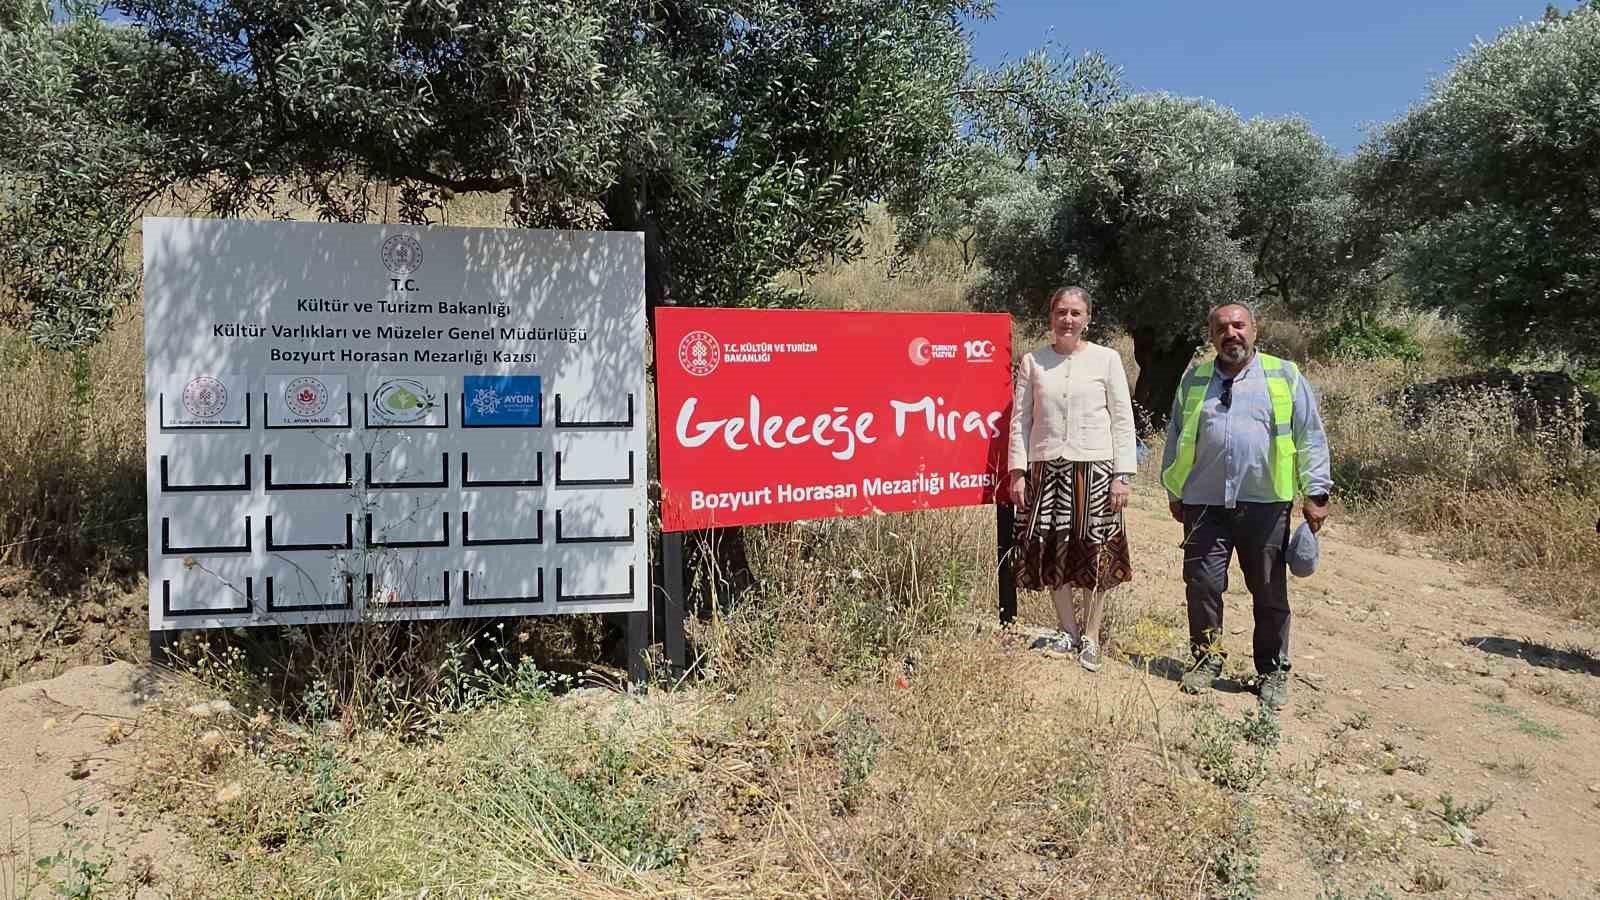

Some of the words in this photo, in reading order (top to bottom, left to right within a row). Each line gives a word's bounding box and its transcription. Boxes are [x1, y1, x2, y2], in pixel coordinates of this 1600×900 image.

[391, 279, 420, 292] T.C.
[297, 298, 349, 313] Kültür
[354, 303, 373, 314] ve
[377, 300, 433, 314] Turizm
[438, 301, 511, 318] Bakanlığı
[213, 323, 267, 338] Kültür
[271, 325, 347, 339] Varlıkları
[352, 329, 372, 340] ve
[377, 326, 443, 341] Müzeler
[448, 327, 495, 341] Genel
[500, 327, 587, 343] Müdürlüğü
[724, 344, 739, 352] T.C.
[740, 342, 773, 353] KÜLTÜR
[774, 344, 785, 352] VE
[786, 343, 818, 353] TURİZM
[270, 349, 336, 365] Bozyurt
[341, 349, 409, 363] Horasan
[414, 350, 488, 366] Mezarlığı
[493, 350, 537, 364] Kazısı
[724, 353, 771, 363] BAKANLIĞI
[504, 394, 535, 404] AYDIN
[675, 394, 877, 461] Geleceğe
[889, 396, 1002, 441] Miras
[690, 486, 772, 512] Bozyurt
[776, 482, 857, 505] Horasan
[862, 474, 944, 497] Mezarlığı
[949, 471, 996, 489] Kazısı
